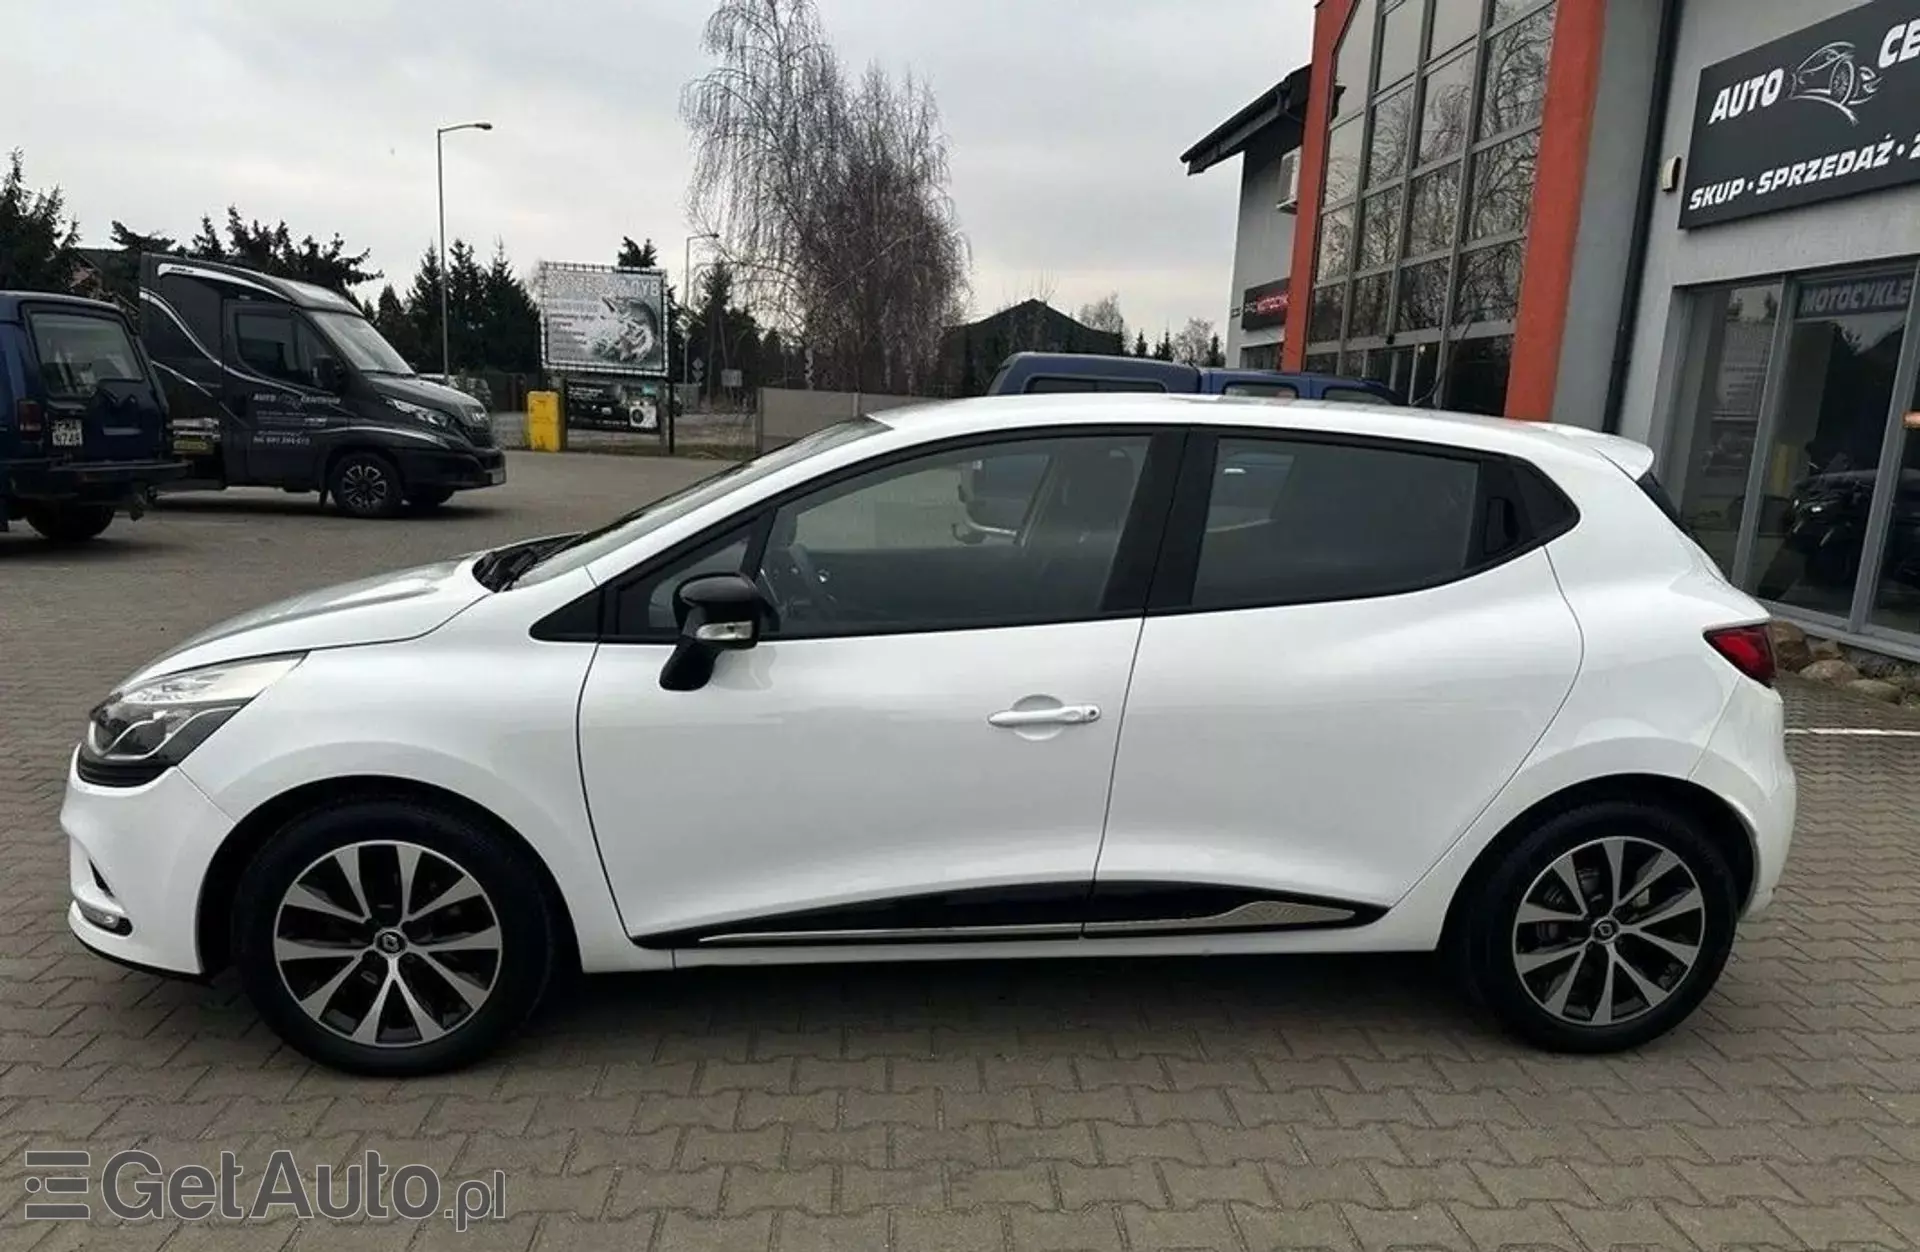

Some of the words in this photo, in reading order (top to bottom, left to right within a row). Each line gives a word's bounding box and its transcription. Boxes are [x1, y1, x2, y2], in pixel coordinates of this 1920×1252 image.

[1707, 67, 1785, 125] AUTO
[1878, 18, 1920, 68] CE
[1688, 177, 1745, 211] SKUP
[1755, 133, 1896, 196] SPRZEDAŻ
[1800, 279, 1911, 313] MOTOCYKLE
